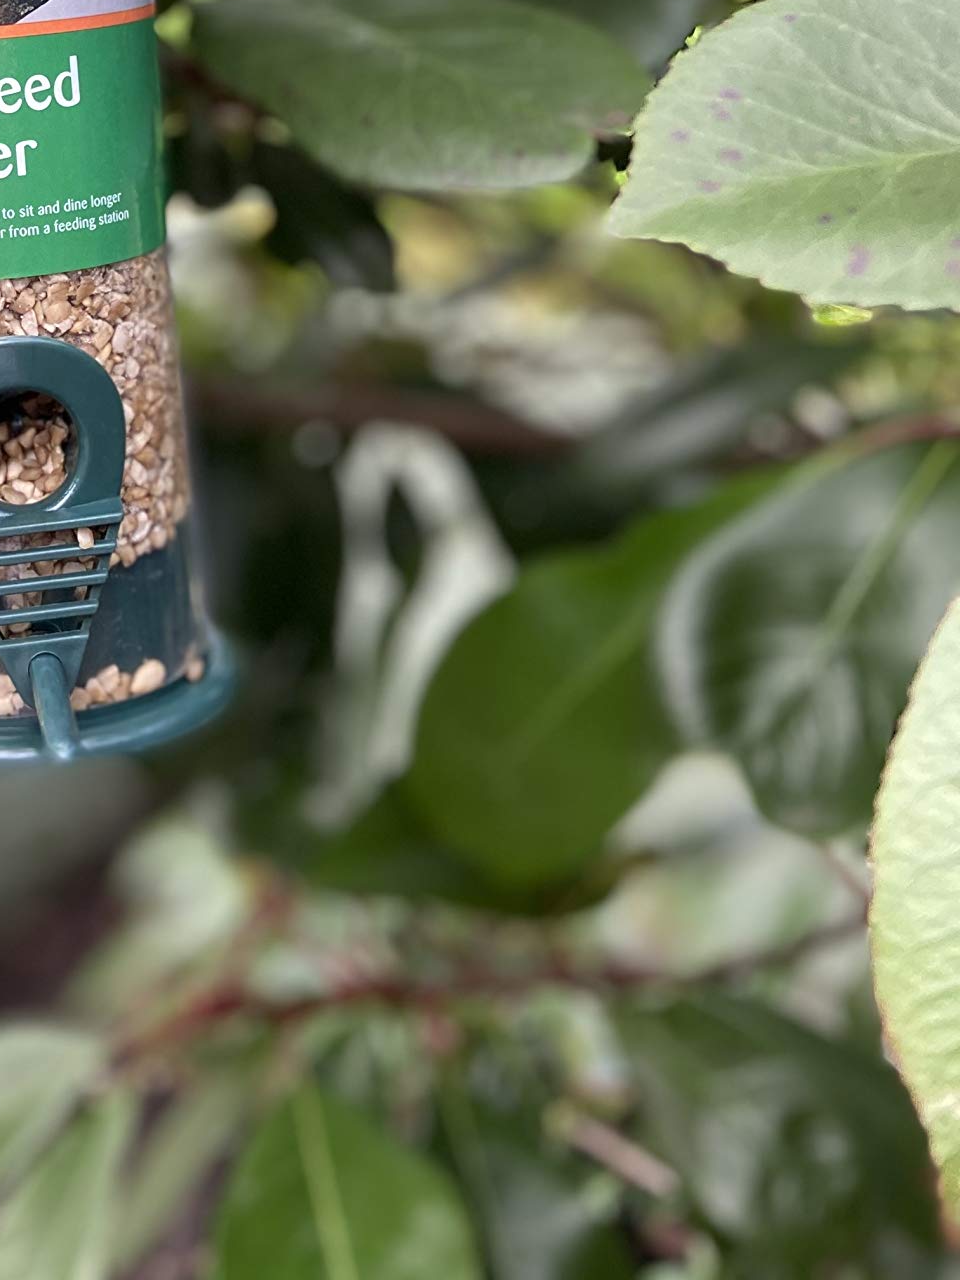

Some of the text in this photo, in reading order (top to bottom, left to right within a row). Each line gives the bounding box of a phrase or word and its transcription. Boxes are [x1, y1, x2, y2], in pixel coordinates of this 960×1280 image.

[2, 207, 15, 220] to
[19, 204, 34, 218] sit
[38, 200, 60, 216] and
[63, 198, 88, 213] dine
[90, 192, 122, 208] longer
[8, 224, 39, 238] from
[43, 223, 51, 234] a
[54, 217, 96, 231] feeding
[98, 209, 129, 226] station
